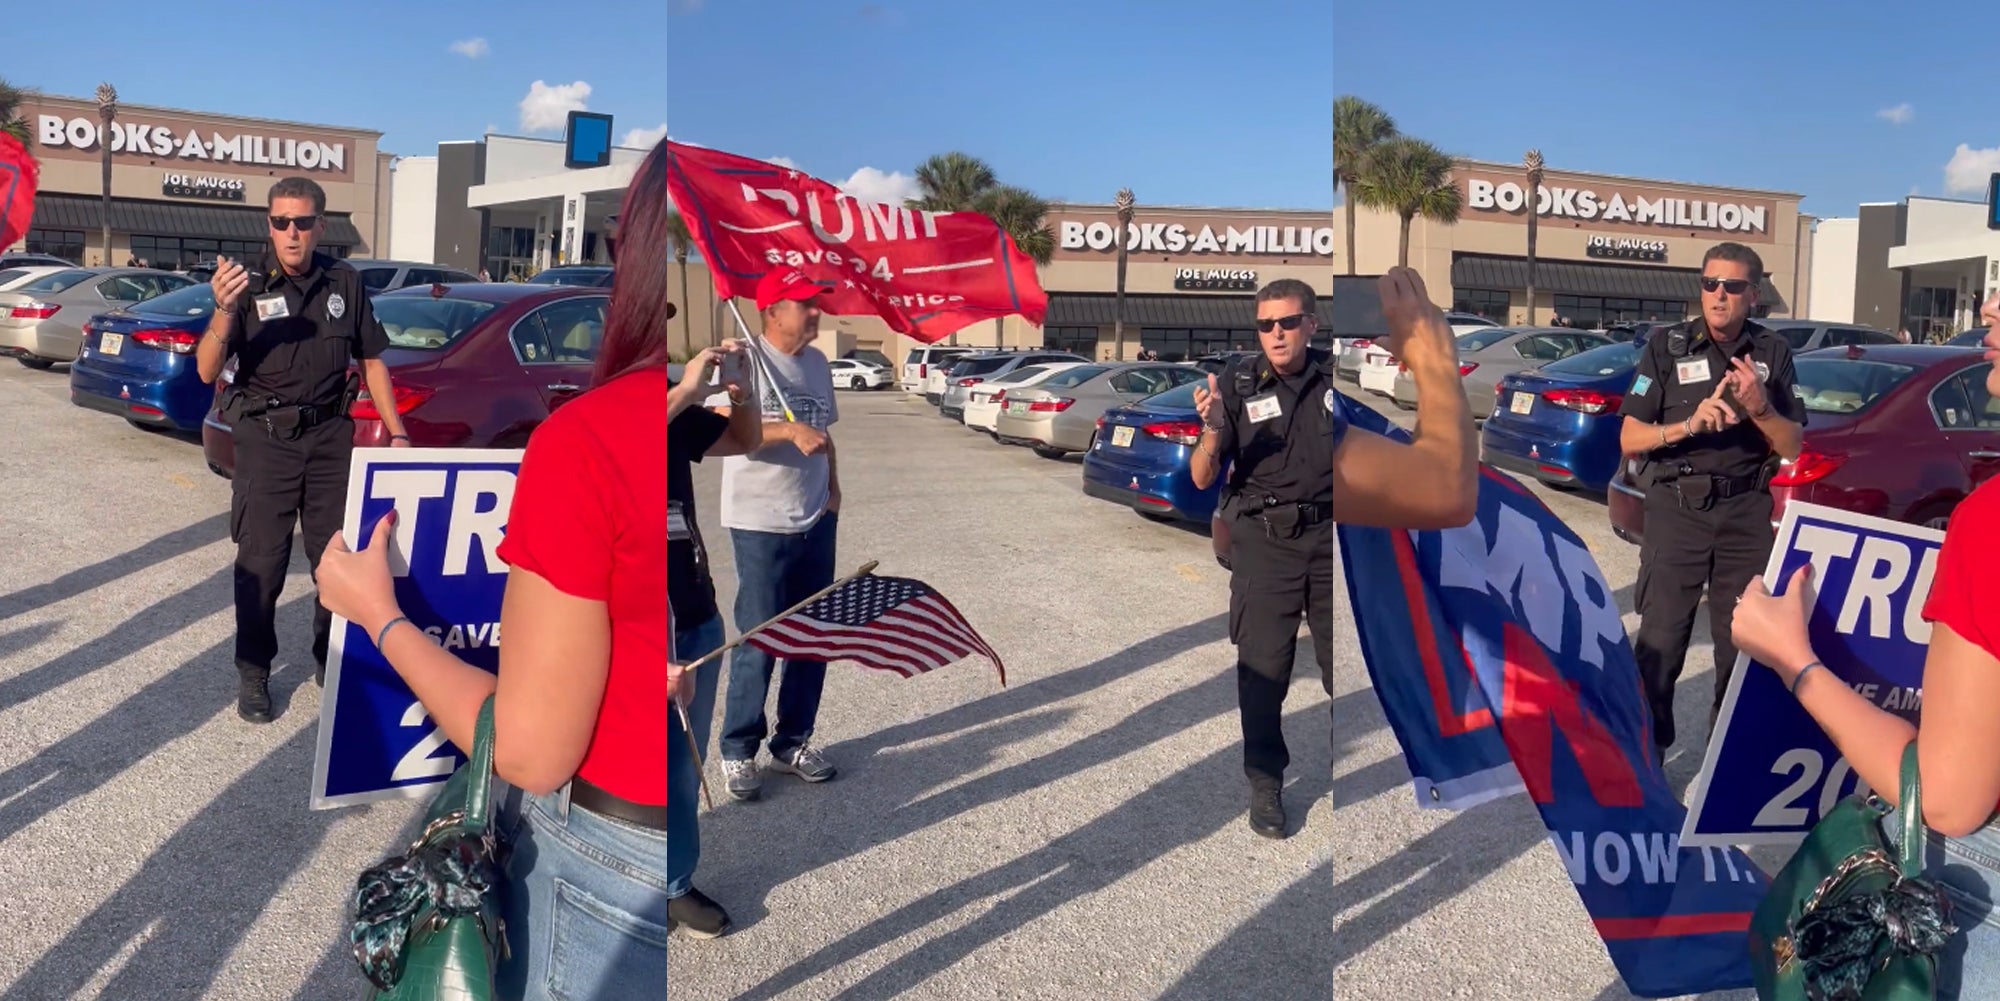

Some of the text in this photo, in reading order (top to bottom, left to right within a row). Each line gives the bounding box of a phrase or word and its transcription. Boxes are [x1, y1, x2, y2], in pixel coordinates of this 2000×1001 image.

[163, 172, 243, 190] JOE MUGGS
[1588, 235, 1665, 251] JOE MUGGS
[1176, 267, 1255, 280] JOE MUGGS
